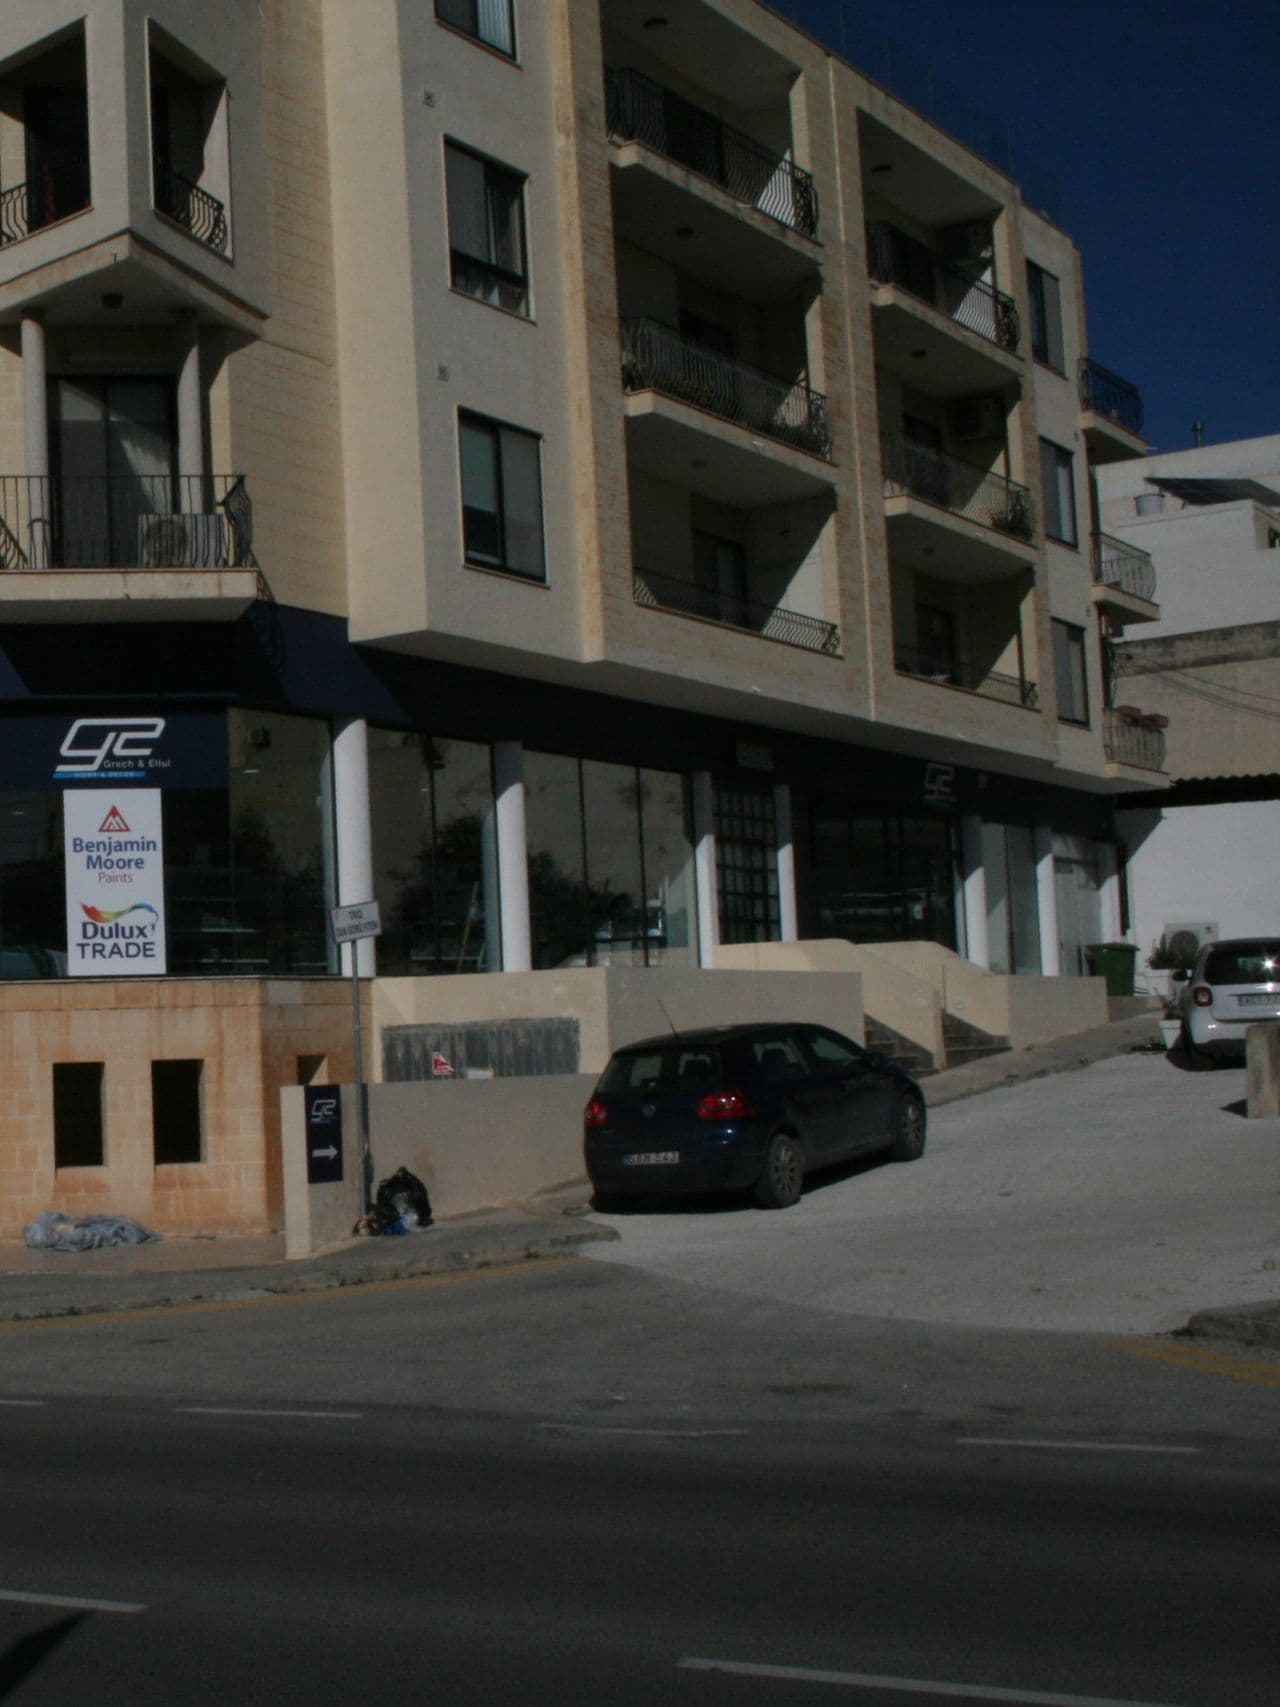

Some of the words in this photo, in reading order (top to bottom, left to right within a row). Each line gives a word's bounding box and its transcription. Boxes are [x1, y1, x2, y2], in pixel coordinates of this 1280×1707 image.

[103, 759, 134, 769] Grech
[137, 759, 145, 769] &
[148, 758, 171, 768] Ellul
[73, 836, 157, 857] Benjamin
[86, 855, 145, 870] Moore
[98, 872, 133, 883] Paints
[81, 922, 148, 940] Dulux
[76, 942, 156, 959] TRADE
